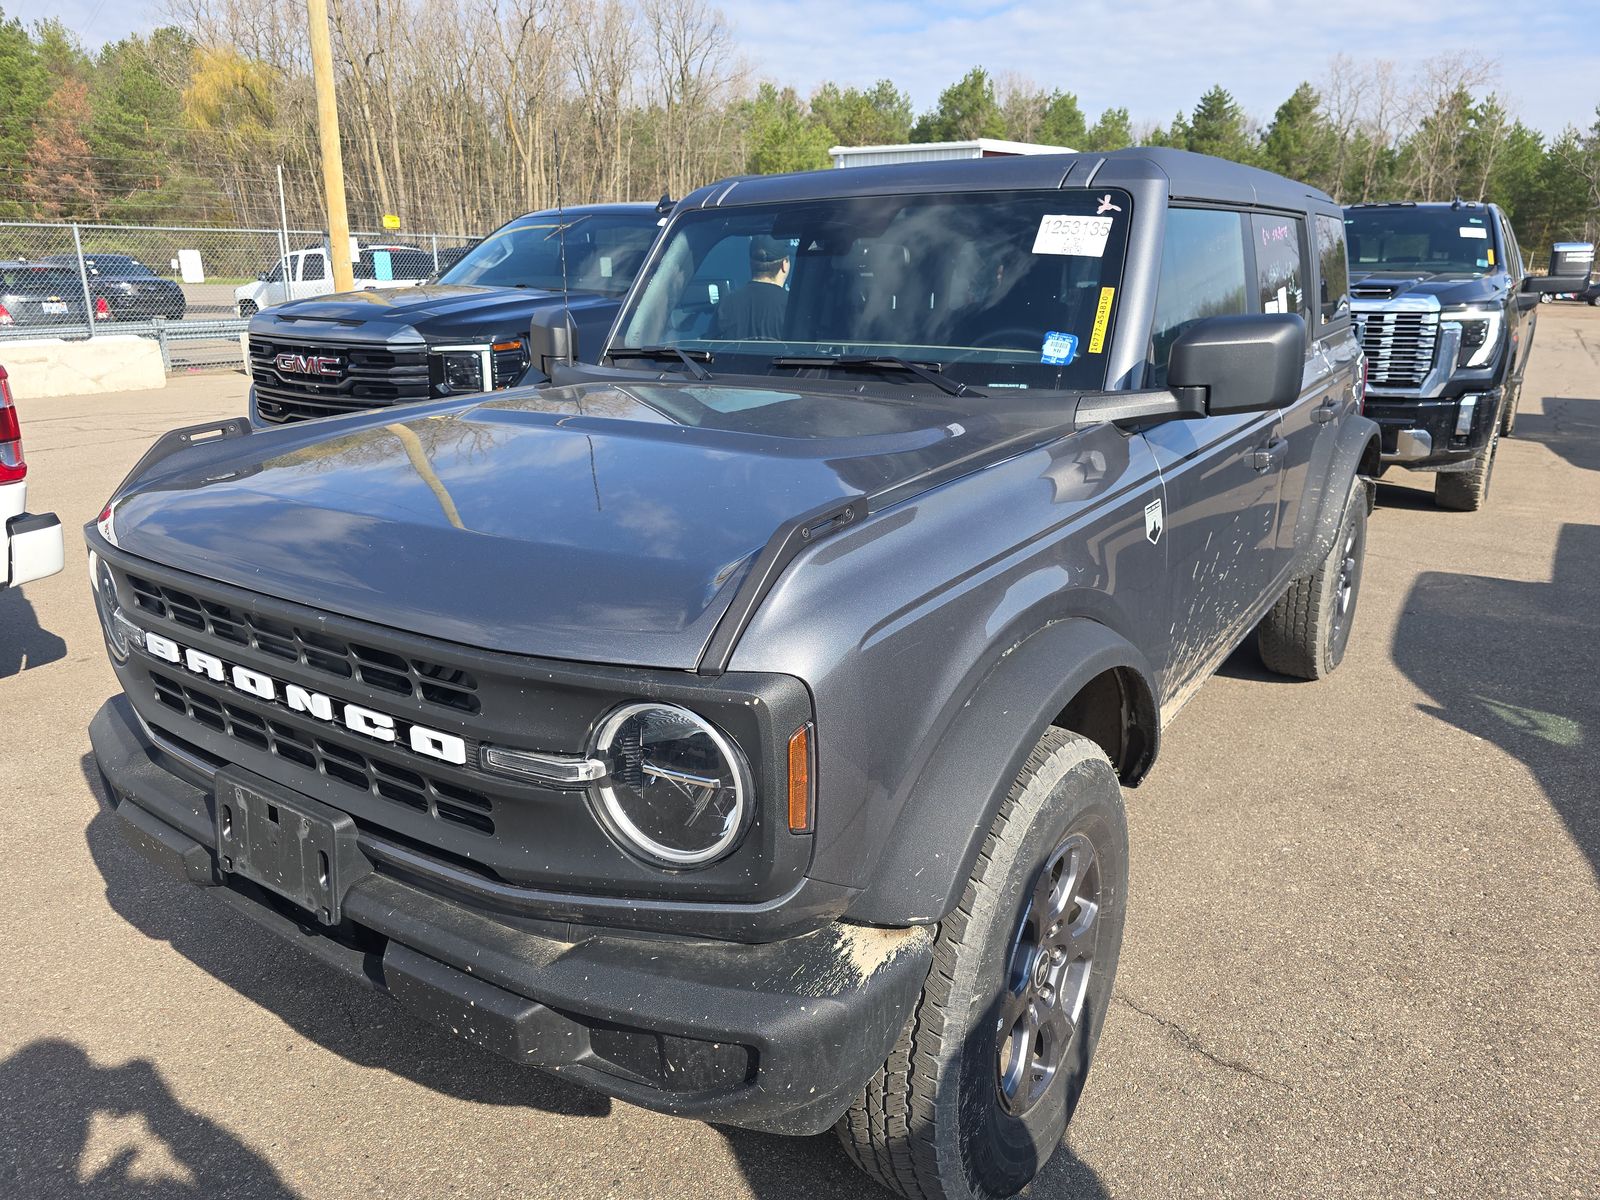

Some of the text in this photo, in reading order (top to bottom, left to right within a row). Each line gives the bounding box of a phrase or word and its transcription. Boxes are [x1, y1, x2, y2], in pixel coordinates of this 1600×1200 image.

[1044, 219, 1110, 237] 1253135
[276, 354, 342, 376] GMC
[146, 632, 467, 765] BRONCO
